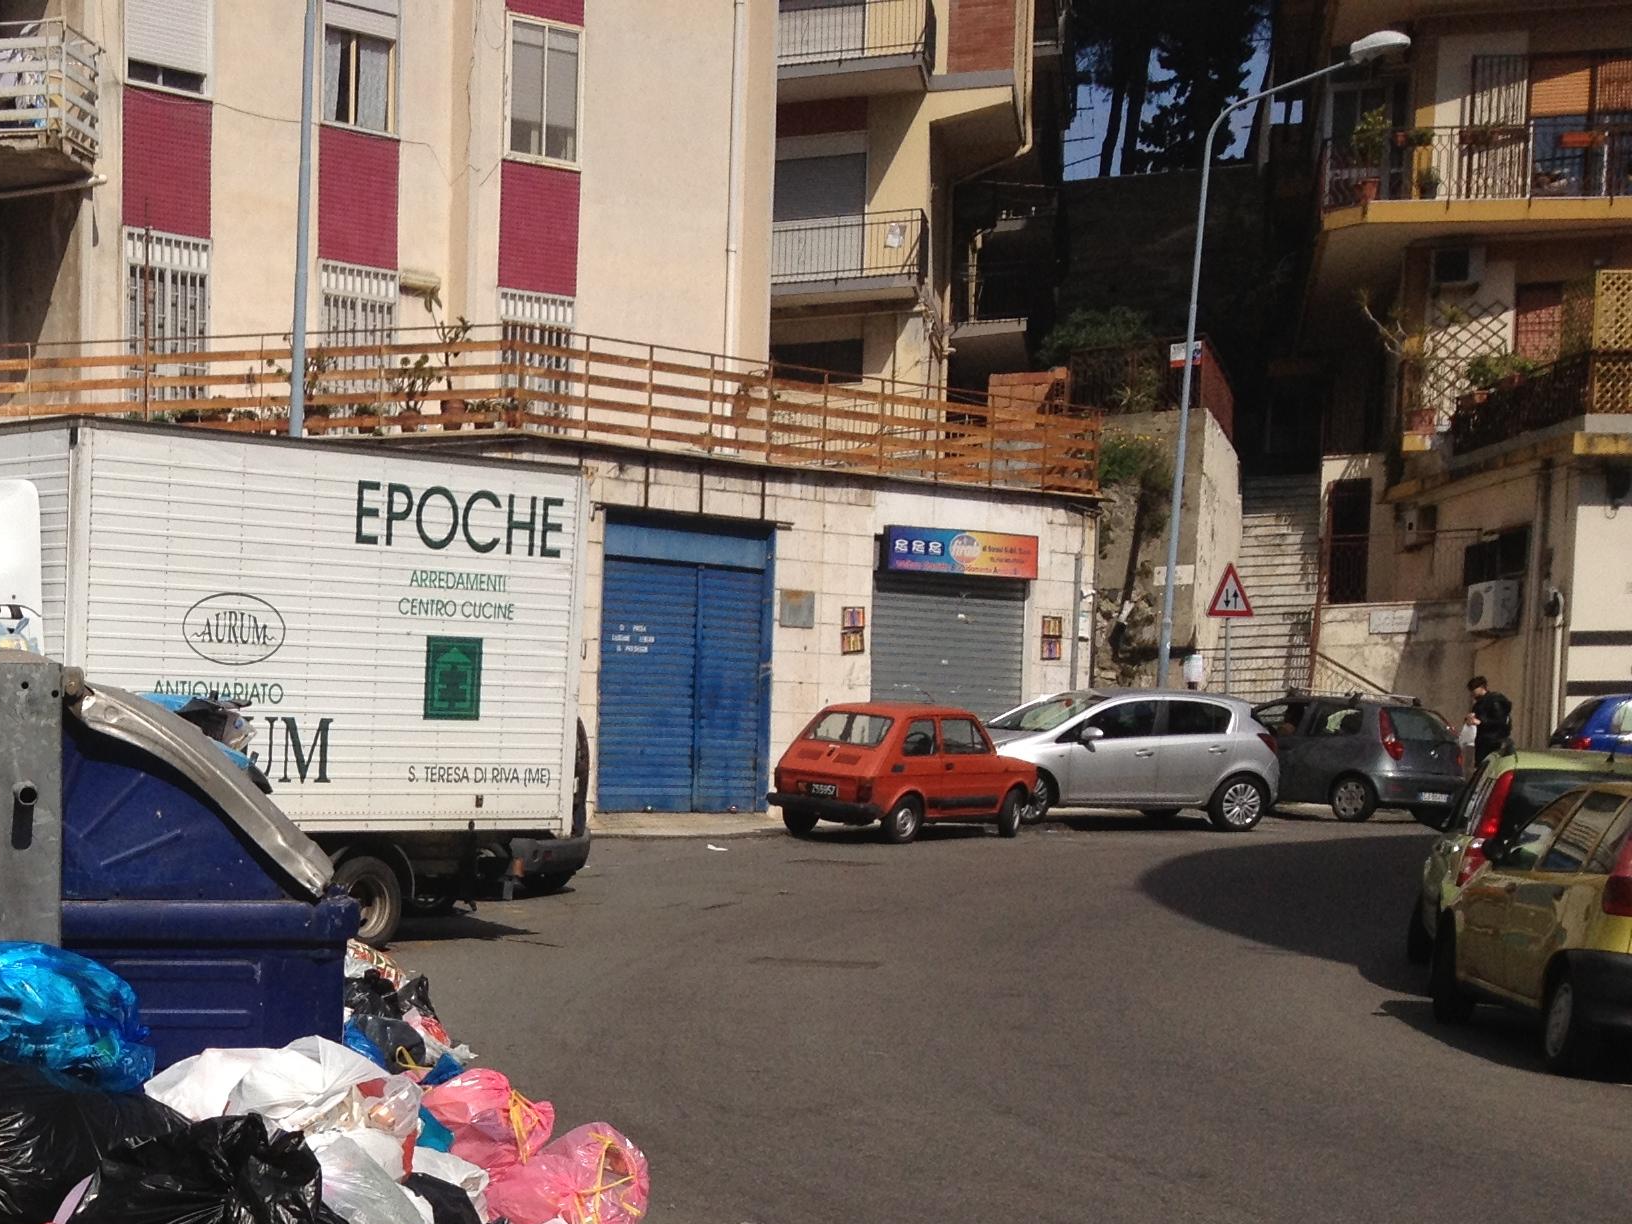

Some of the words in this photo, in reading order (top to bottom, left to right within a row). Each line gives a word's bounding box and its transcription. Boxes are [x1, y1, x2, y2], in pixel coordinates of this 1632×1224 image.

[355, 480, 565, 559] EPOCHE
[409, 569, 507, 591] ARREDAMENTI
[398, 597, 457, 617] CENTRO
[461, 600, 515, 621] CUCINE
[198, 610, 269, 646] AURUM
[408, 765, 420, 783] S.
[424, 765, 470, 784] TERESA
[474, 767, 486, 784] DI
[490, 767, 521, 785] RIVA
[523, 766, 551, 787] (ME)
